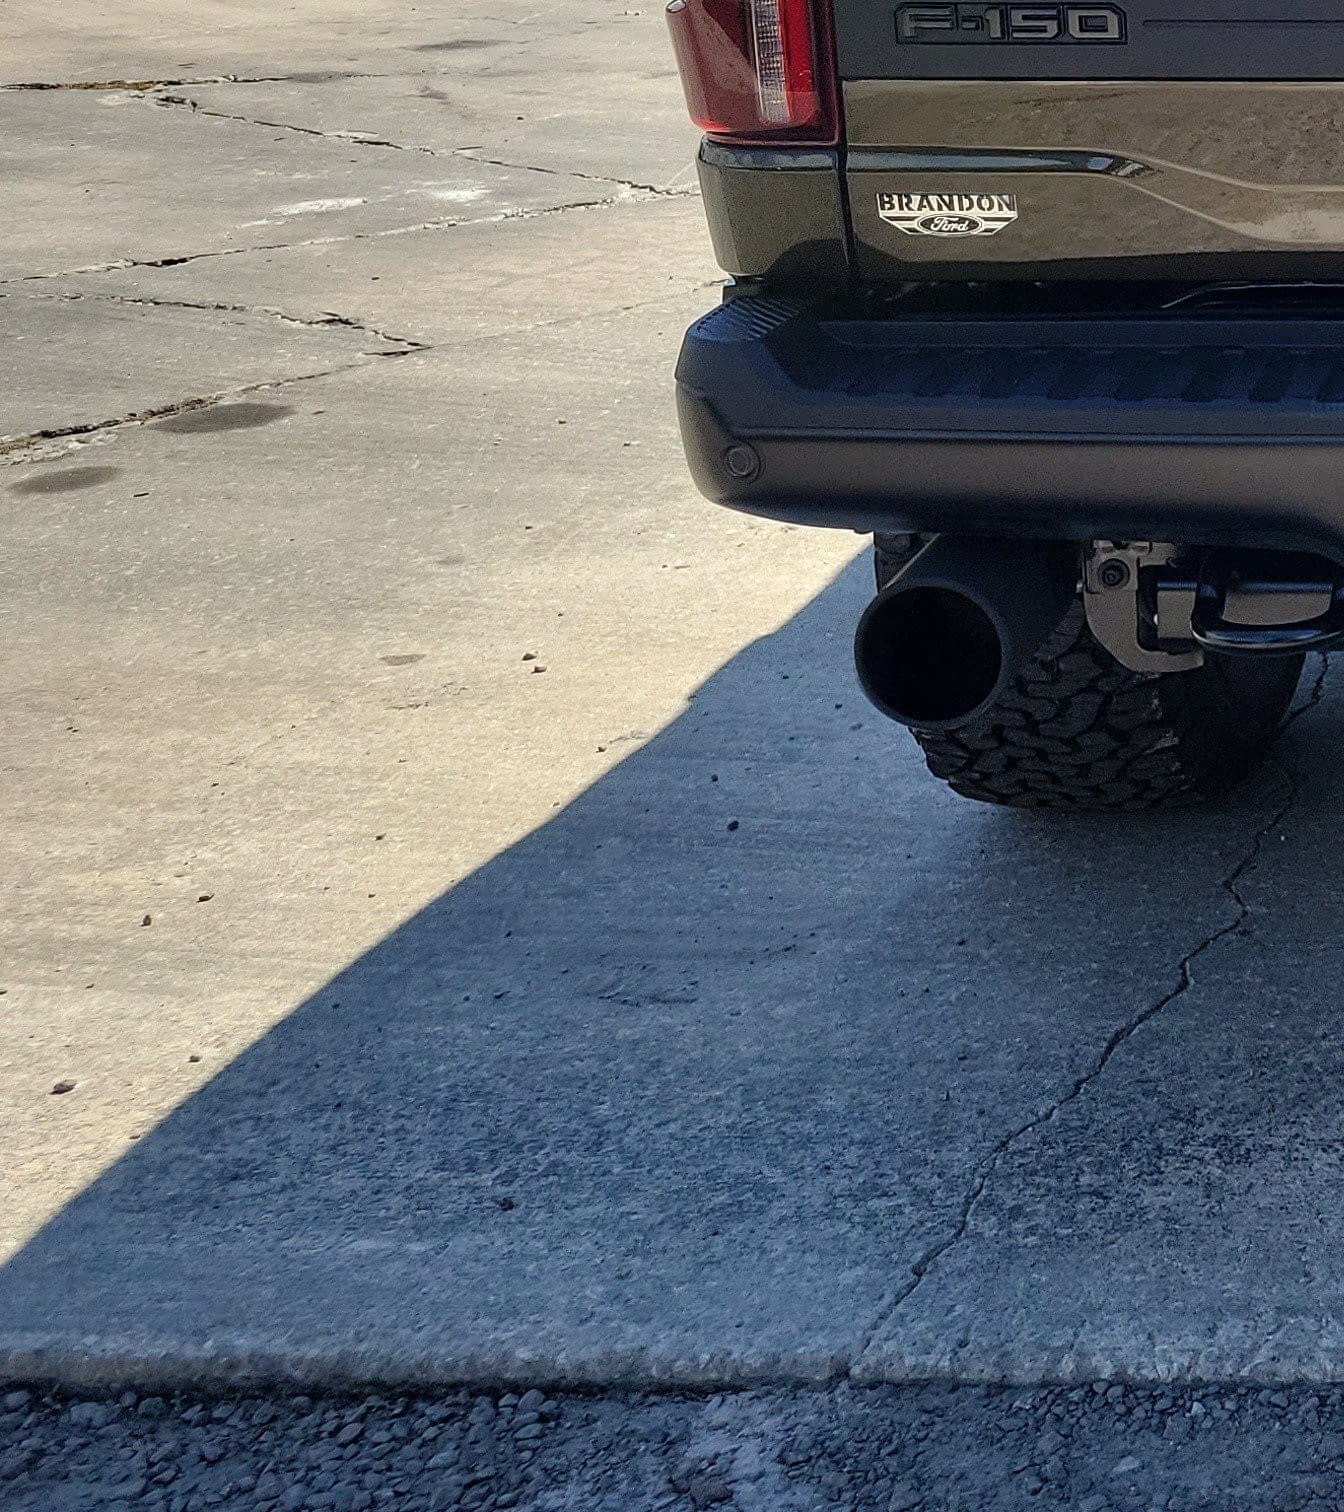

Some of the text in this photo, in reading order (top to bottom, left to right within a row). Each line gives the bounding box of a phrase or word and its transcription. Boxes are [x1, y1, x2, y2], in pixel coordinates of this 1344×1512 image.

[895, 2, 1127, 44] F-150
[879, 193, 1016, 212] BRANDON
[930, 216, 969, 232] Ford
